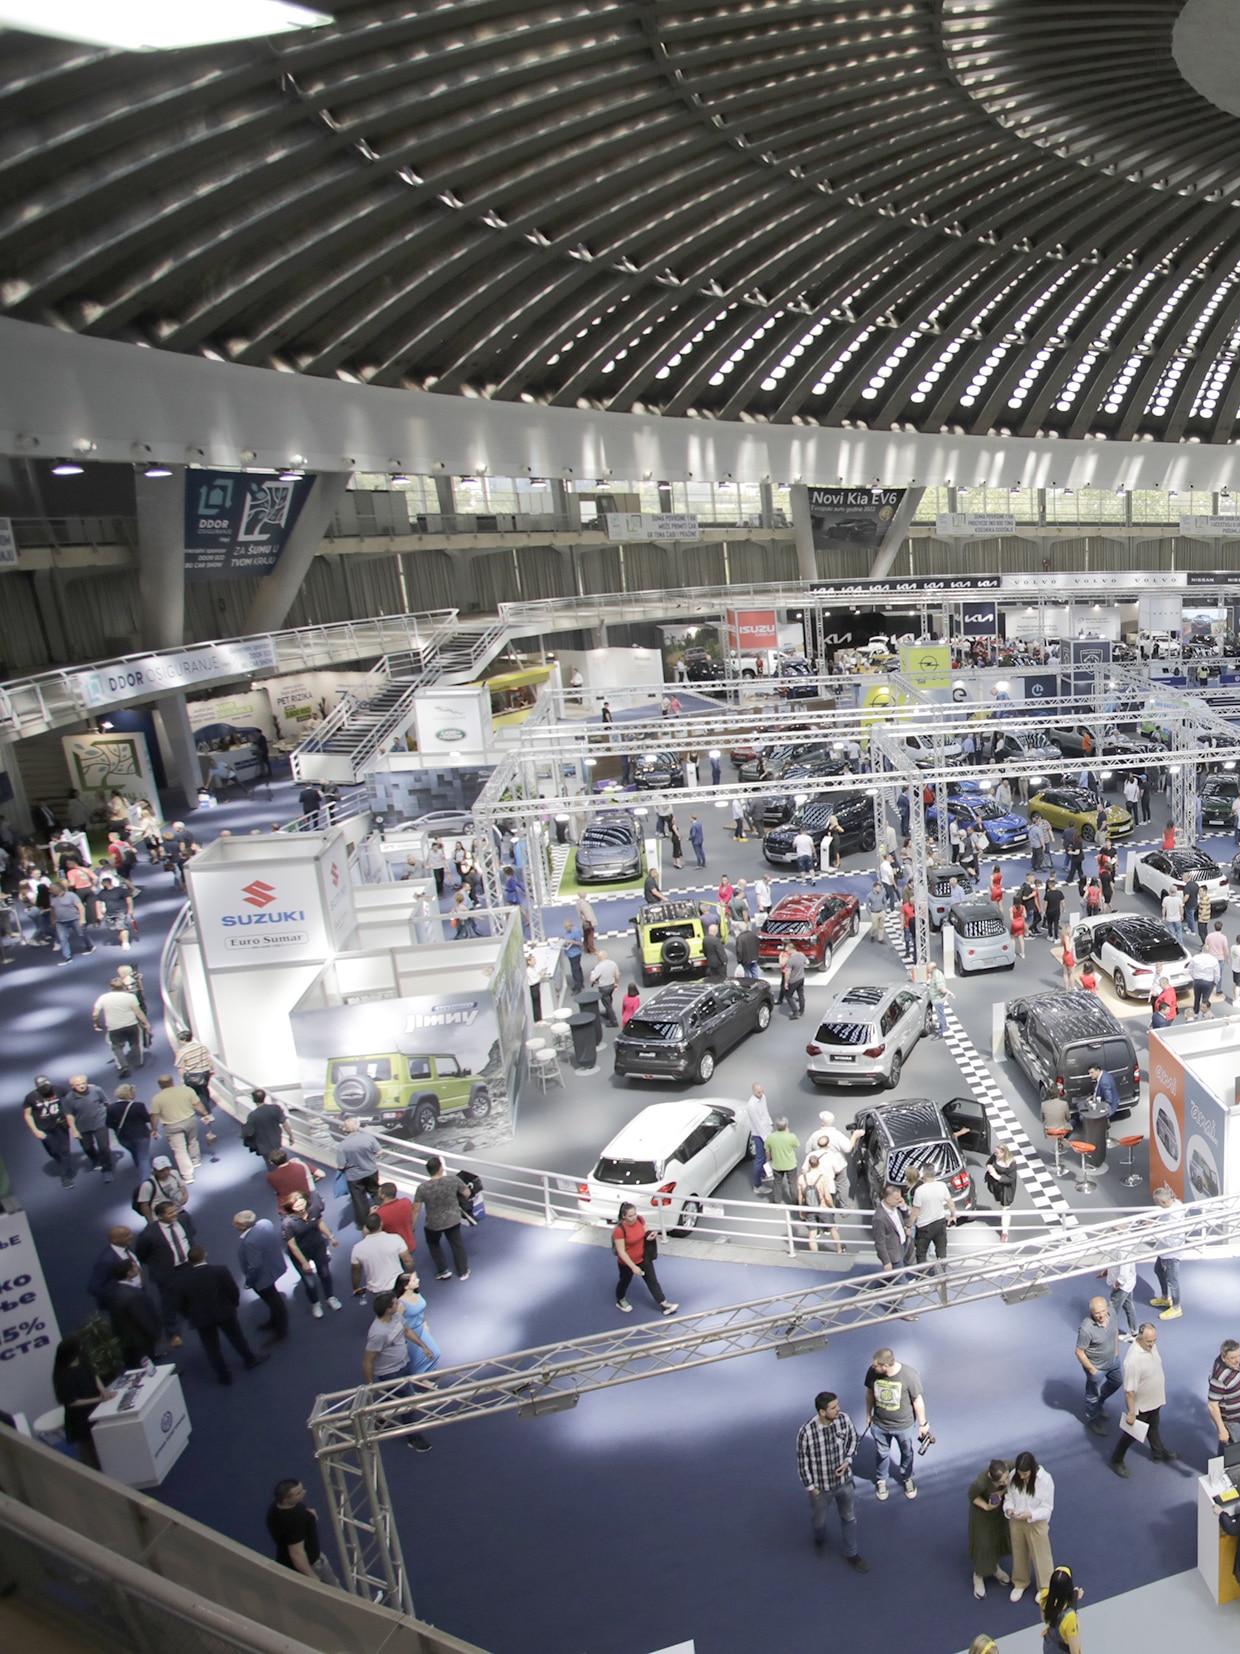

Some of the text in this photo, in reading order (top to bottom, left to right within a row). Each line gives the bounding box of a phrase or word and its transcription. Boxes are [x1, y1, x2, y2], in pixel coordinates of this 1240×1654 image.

[812, 491, 897, 505] Novi Kia EV6
[199, 519, 229, 529] DDOR
[233, 544, 280, 556] ZA ŠUMU U
[231, 557, 277, 567] TVOM KRAJU
[924, 581, 944, 589] KIA
[951, 580, 971, 588] KIA
[977, 580, 998, 588] KIA
[965, 613, 994, 623] KIA
[739, 624, 775, 634] ISUZU
[824, 632, 852, 644] KIA
[108, 655, 219, 692] DDOR OSIGURANJE
[277, 692, 314, 706] PET RIZIKA
[221, 910, 305, 927] SUZUKI
[231, 938, 260, 947] Euro
[263, 934, 304, 944] Sumar
[403, 1009, 479, 1034] Jimny
